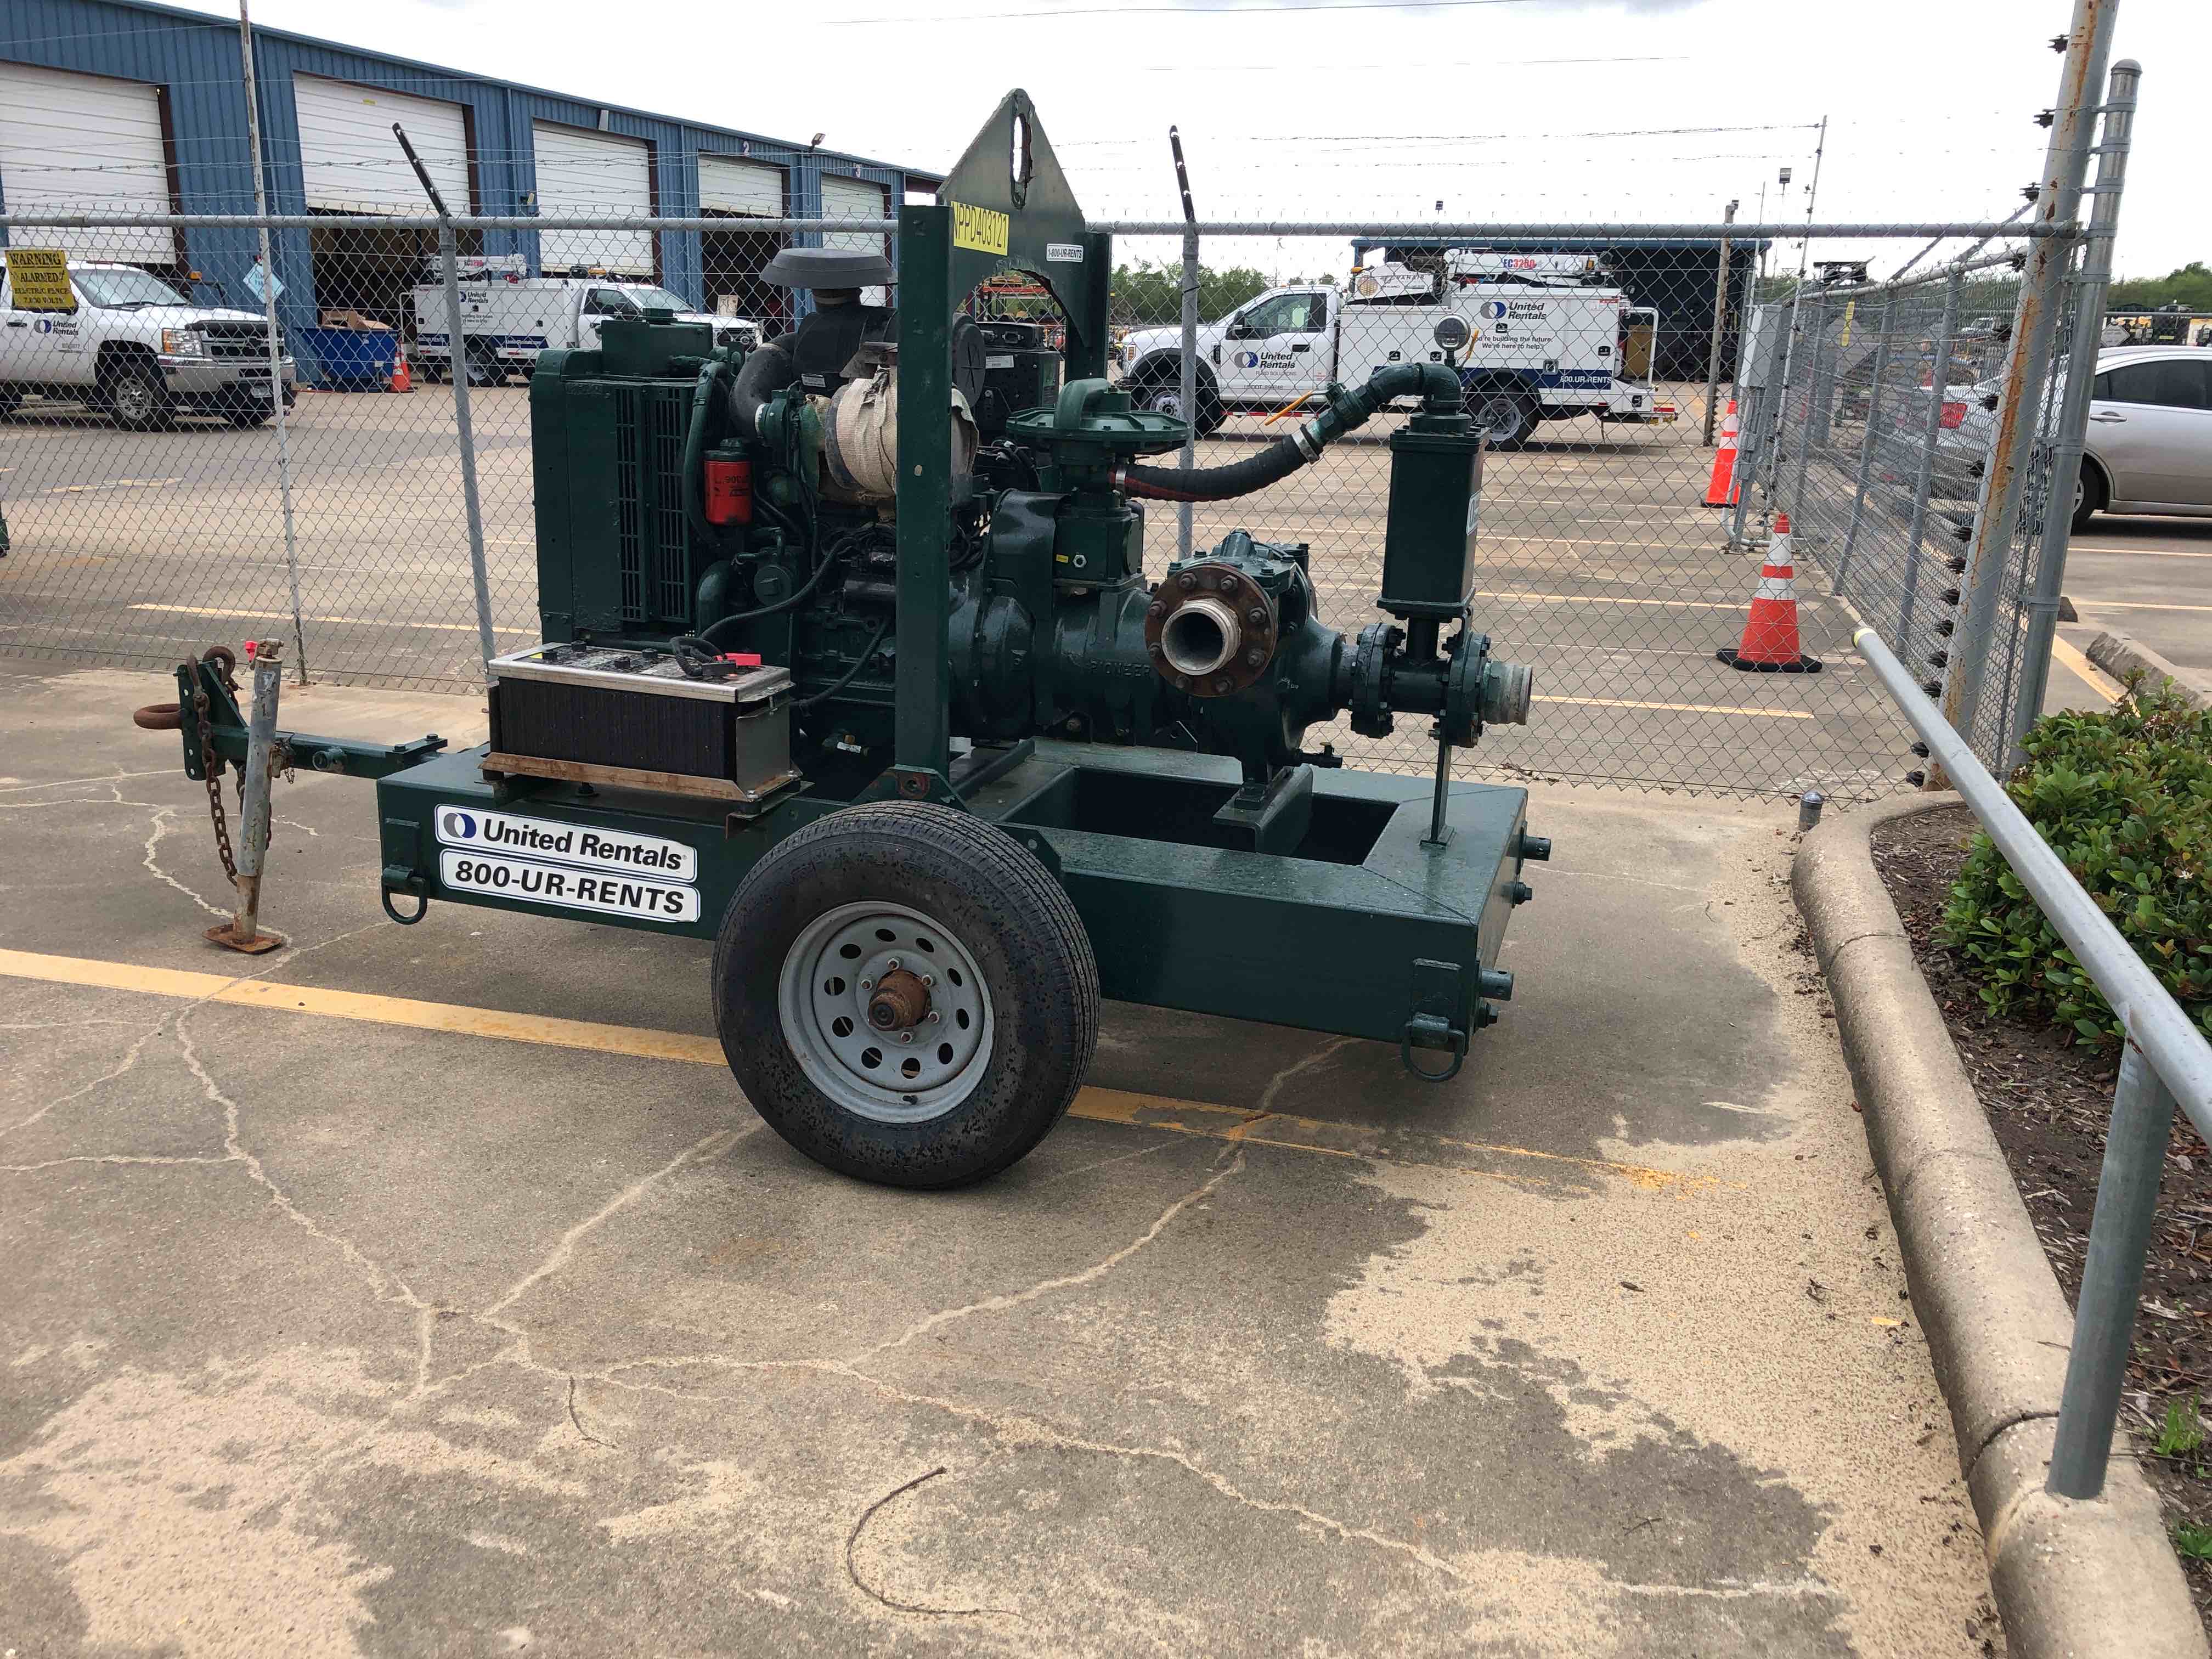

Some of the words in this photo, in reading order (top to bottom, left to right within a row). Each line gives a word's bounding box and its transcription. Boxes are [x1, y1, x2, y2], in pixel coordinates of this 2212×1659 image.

[9, 253, 61, 264] WARNING
[1047, 248, 1083, 259] 1-800-UR-RENTS
[20, 272, 58, 282] ALARMED
[1509, 302, 1545, 311] United
[1509, 312, 1547, 320] Rentals
[1260, 352, 1294, 360] United
[483, 819, 574, 853] United
[579, 833, 682, 870] Rentals
[455, 860, 684, 915] 800-UR-RENTS
